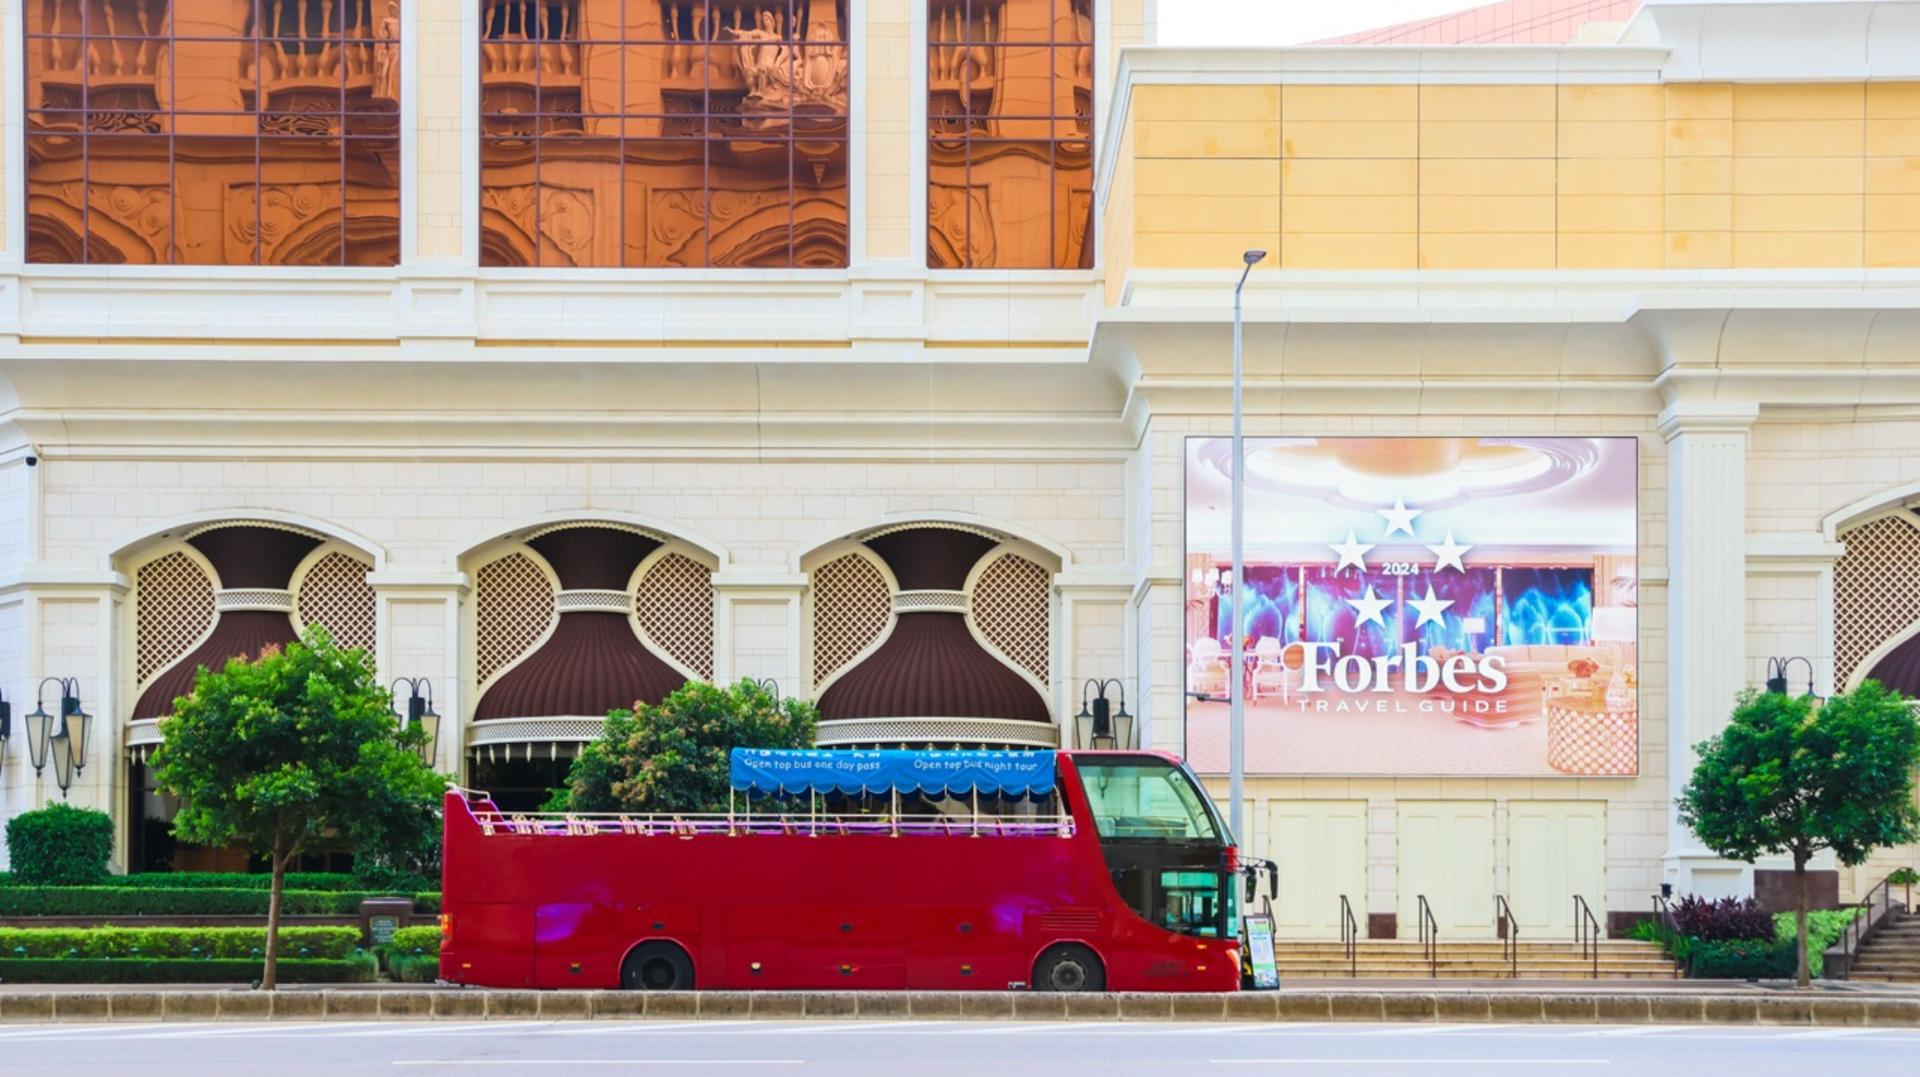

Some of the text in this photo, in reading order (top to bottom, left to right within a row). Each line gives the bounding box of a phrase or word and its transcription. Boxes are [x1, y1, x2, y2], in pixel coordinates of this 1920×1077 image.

[1382, 562, 1419, 575] 2024
[1297, 641, 1508, 693] Forbes
[1297, 700, 1508, 712] TRAVEL GUIDE
[744, 758, 880, 772] Open top bus one day pass
[914, 759, 1037, 773] Open top bus night tour
